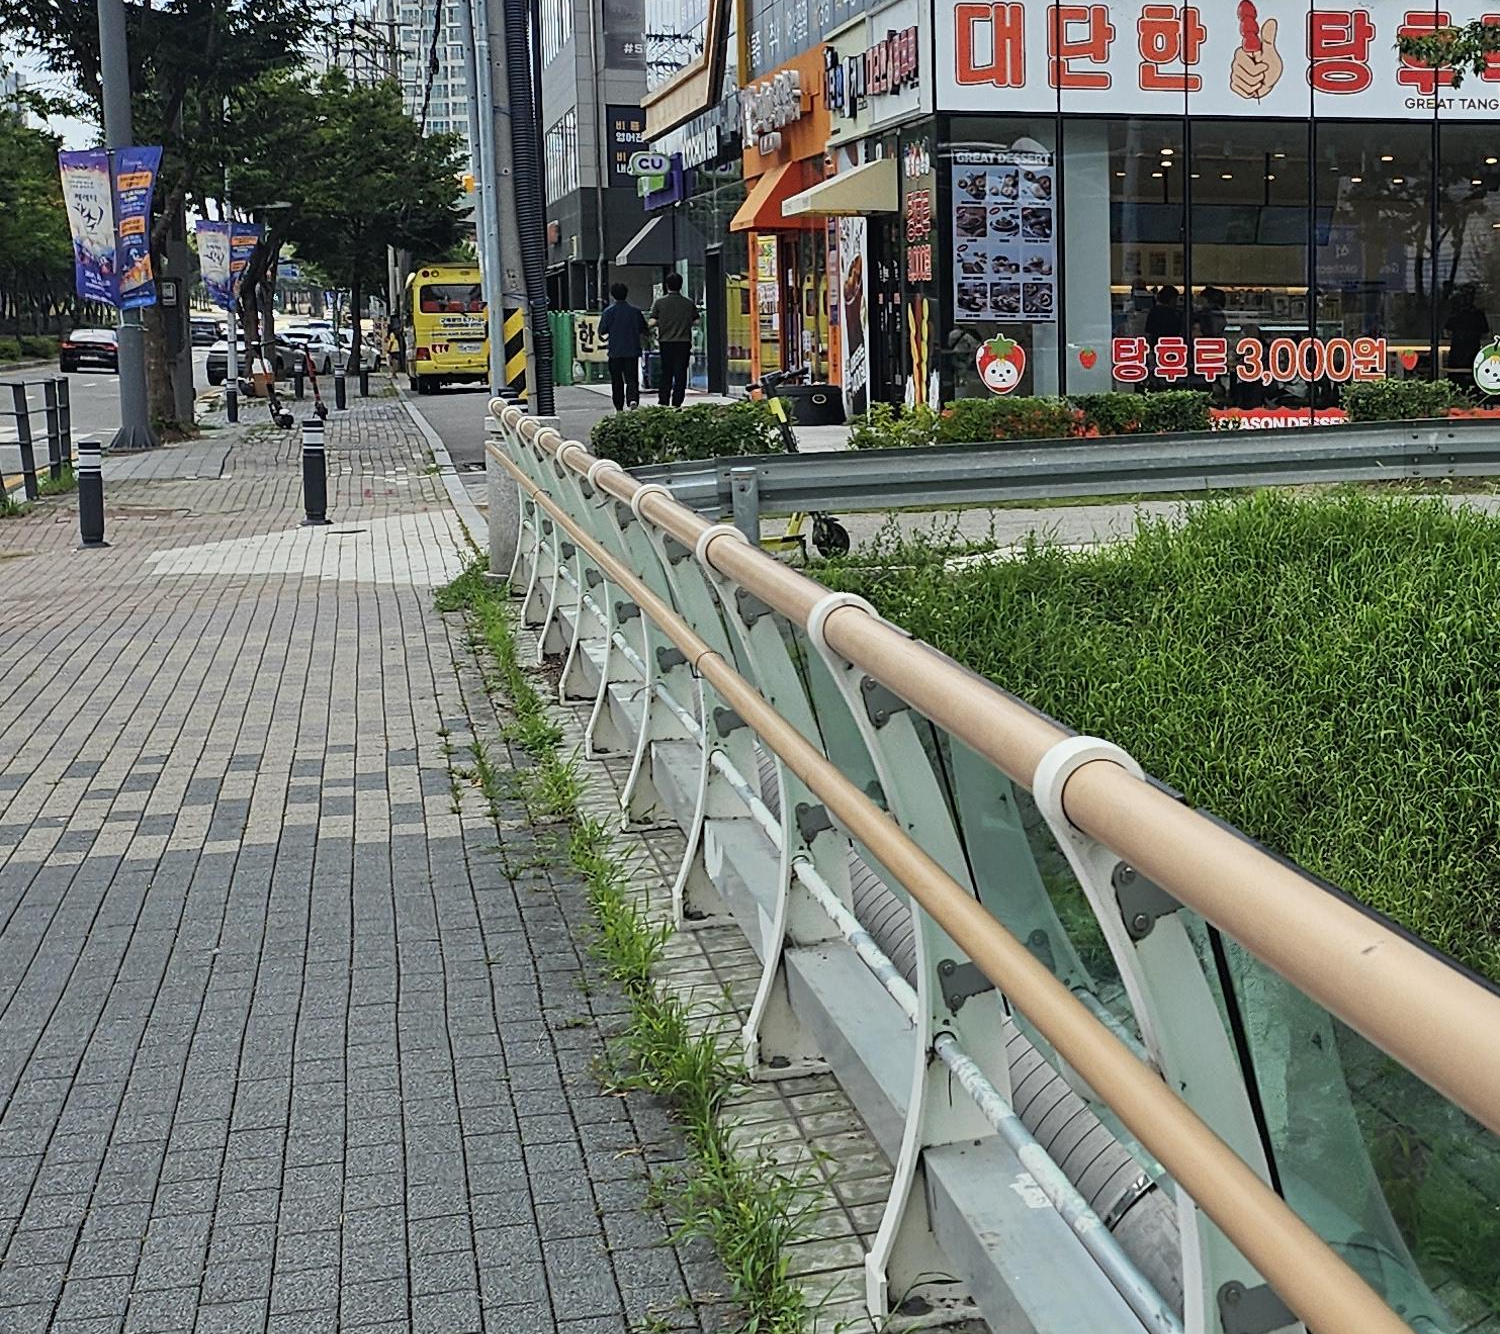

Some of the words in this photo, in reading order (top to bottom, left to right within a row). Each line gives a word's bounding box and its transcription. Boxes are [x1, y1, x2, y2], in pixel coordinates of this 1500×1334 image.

[954, 1, 1206, 92] 대단한
[1404, 98, 1455, 109] GREAT
[638, 155, 663, 171] CU
[956, 152, 996, 163] GREAT
[998, 152, 1051, 165] DESSERT
[1111, 336, 1229, 382] 탕후루
[1236, 336, 1387, 386] 3,000원
